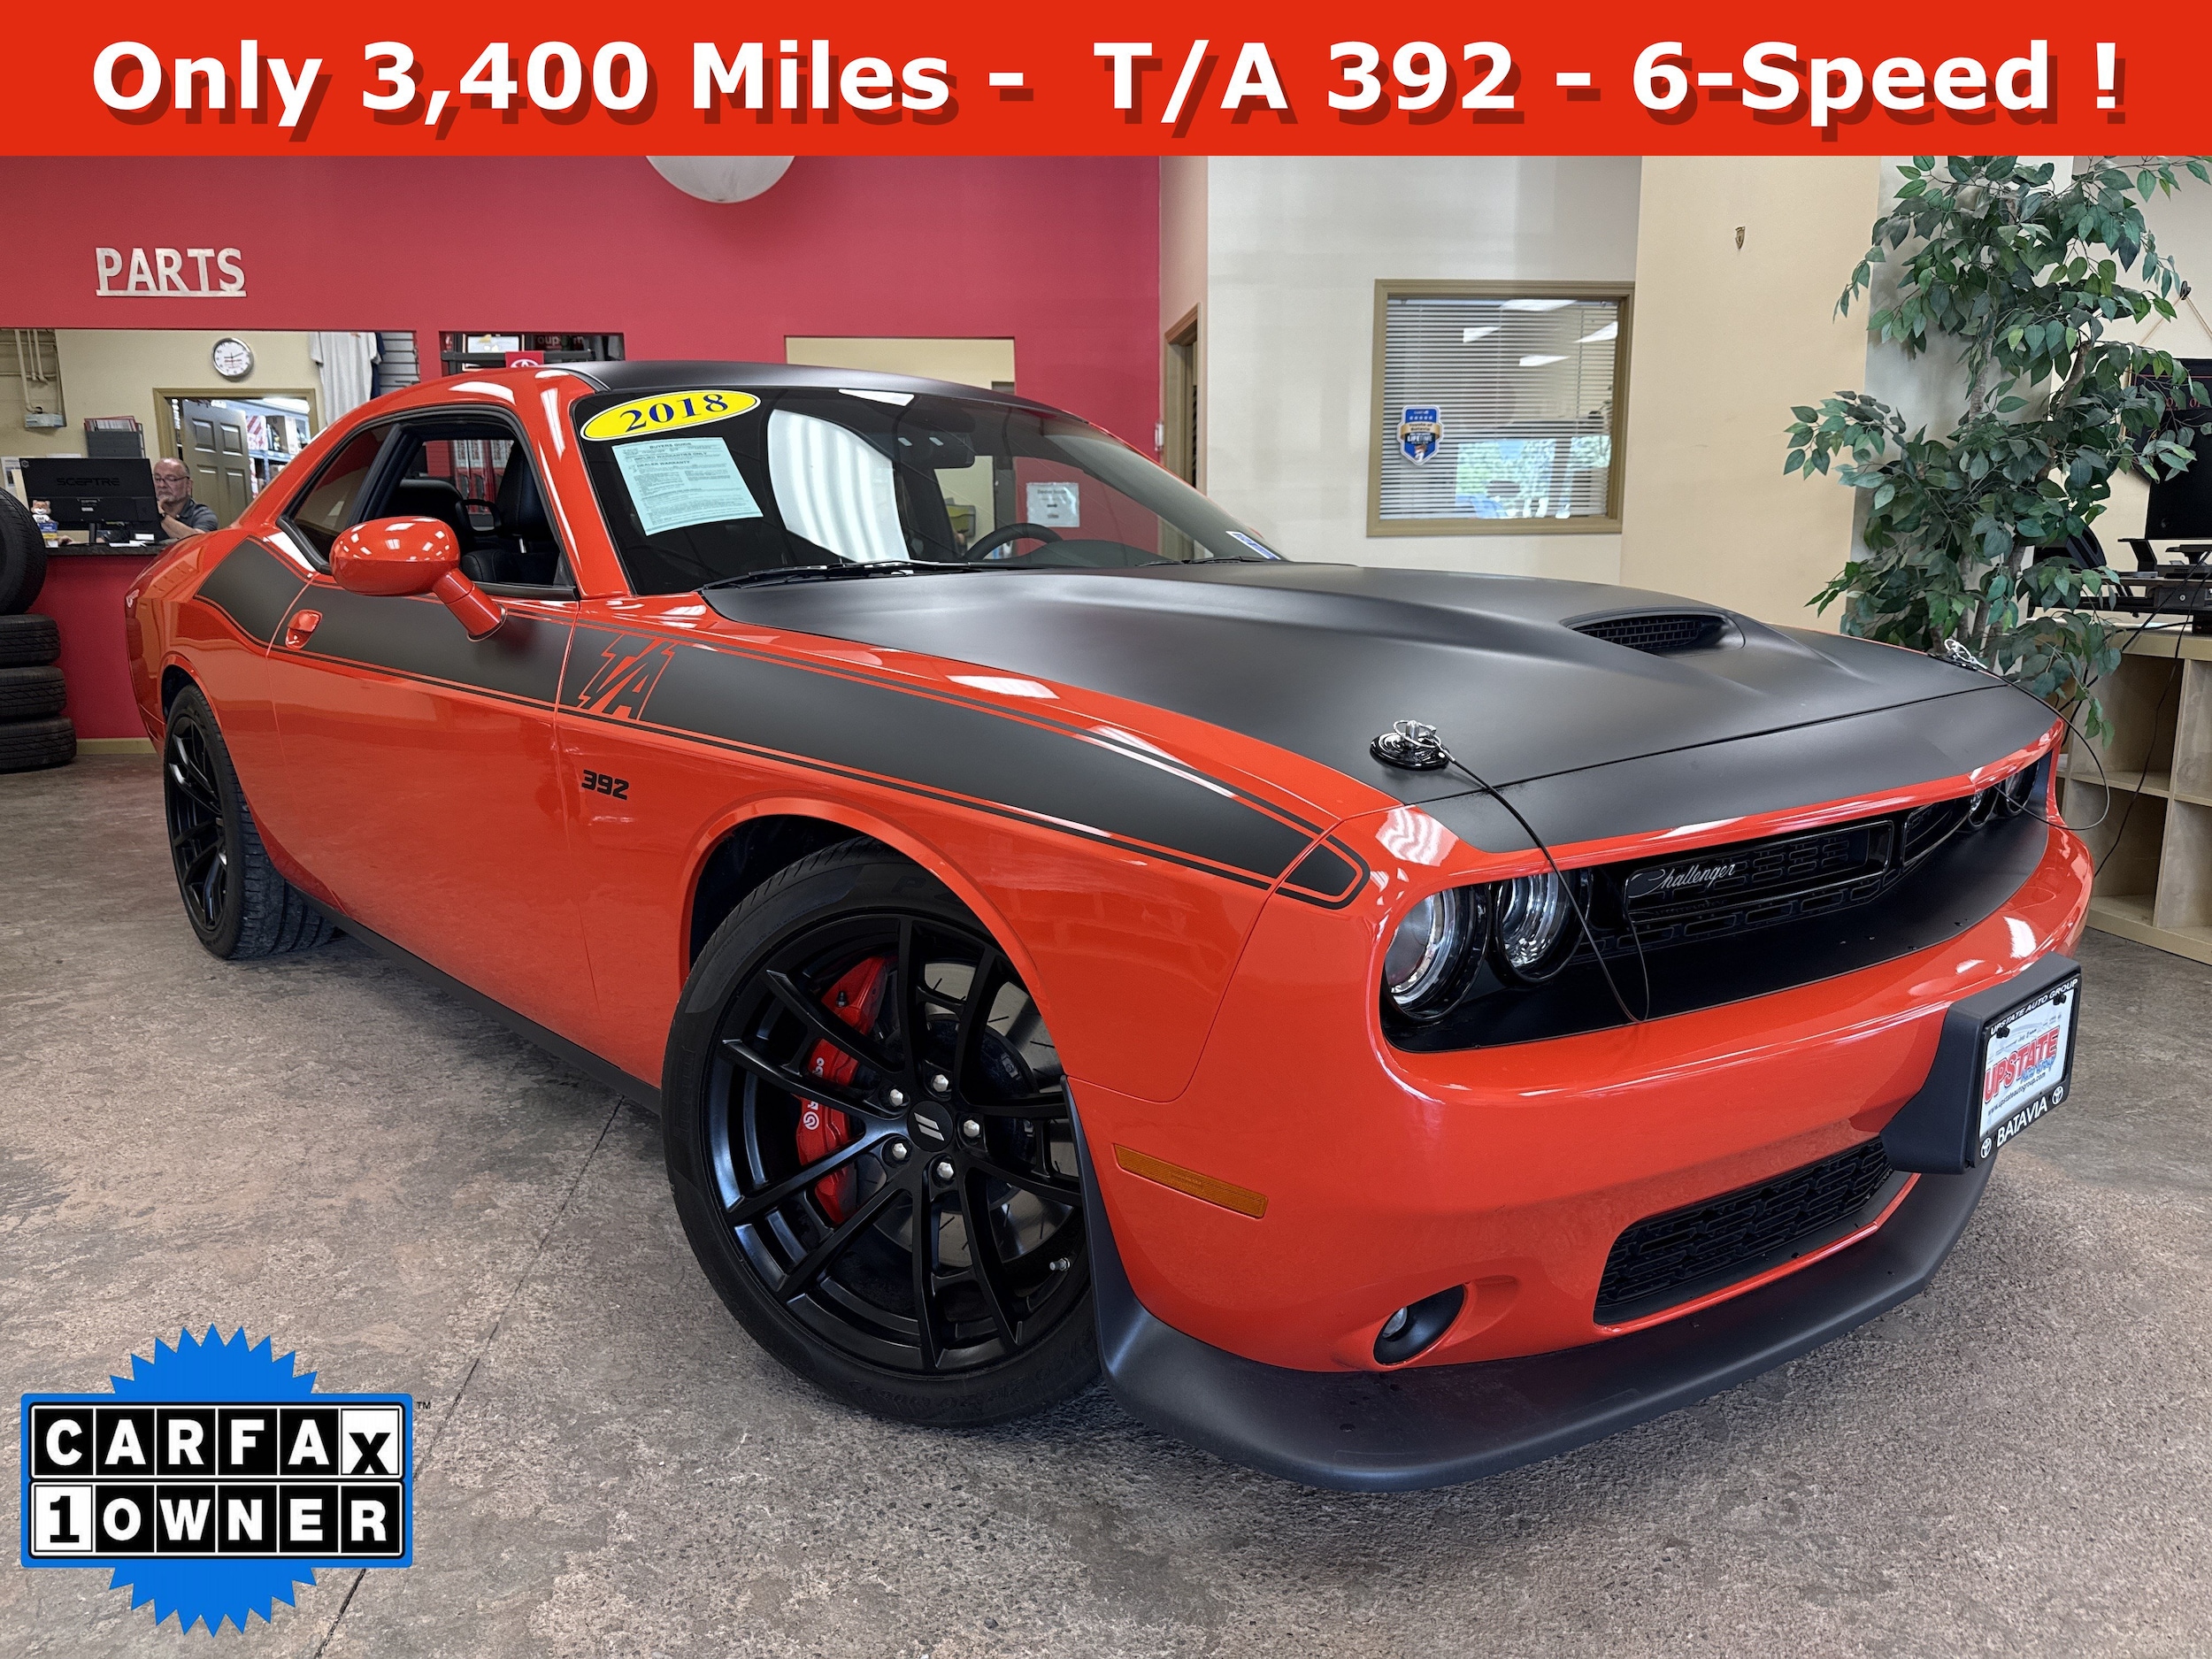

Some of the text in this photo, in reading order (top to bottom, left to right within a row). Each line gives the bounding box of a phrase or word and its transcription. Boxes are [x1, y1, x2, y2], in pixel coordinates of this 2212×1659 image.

[96, 247, 246, 295] PARTS
[619, 394, 728, 433] 2018
[57, 477, 120, 487] SCEPTRE
[581, 769, 630, 801] 392
[1627, 863, 1736, 899] Challenger
[1990, 979, 2078, 1035] UPSTATE AUTO GROUP
[1984, 1025, 2061, 1104] UPSTATE
[1997, 1096, 2048, 1148] BATAVIA
